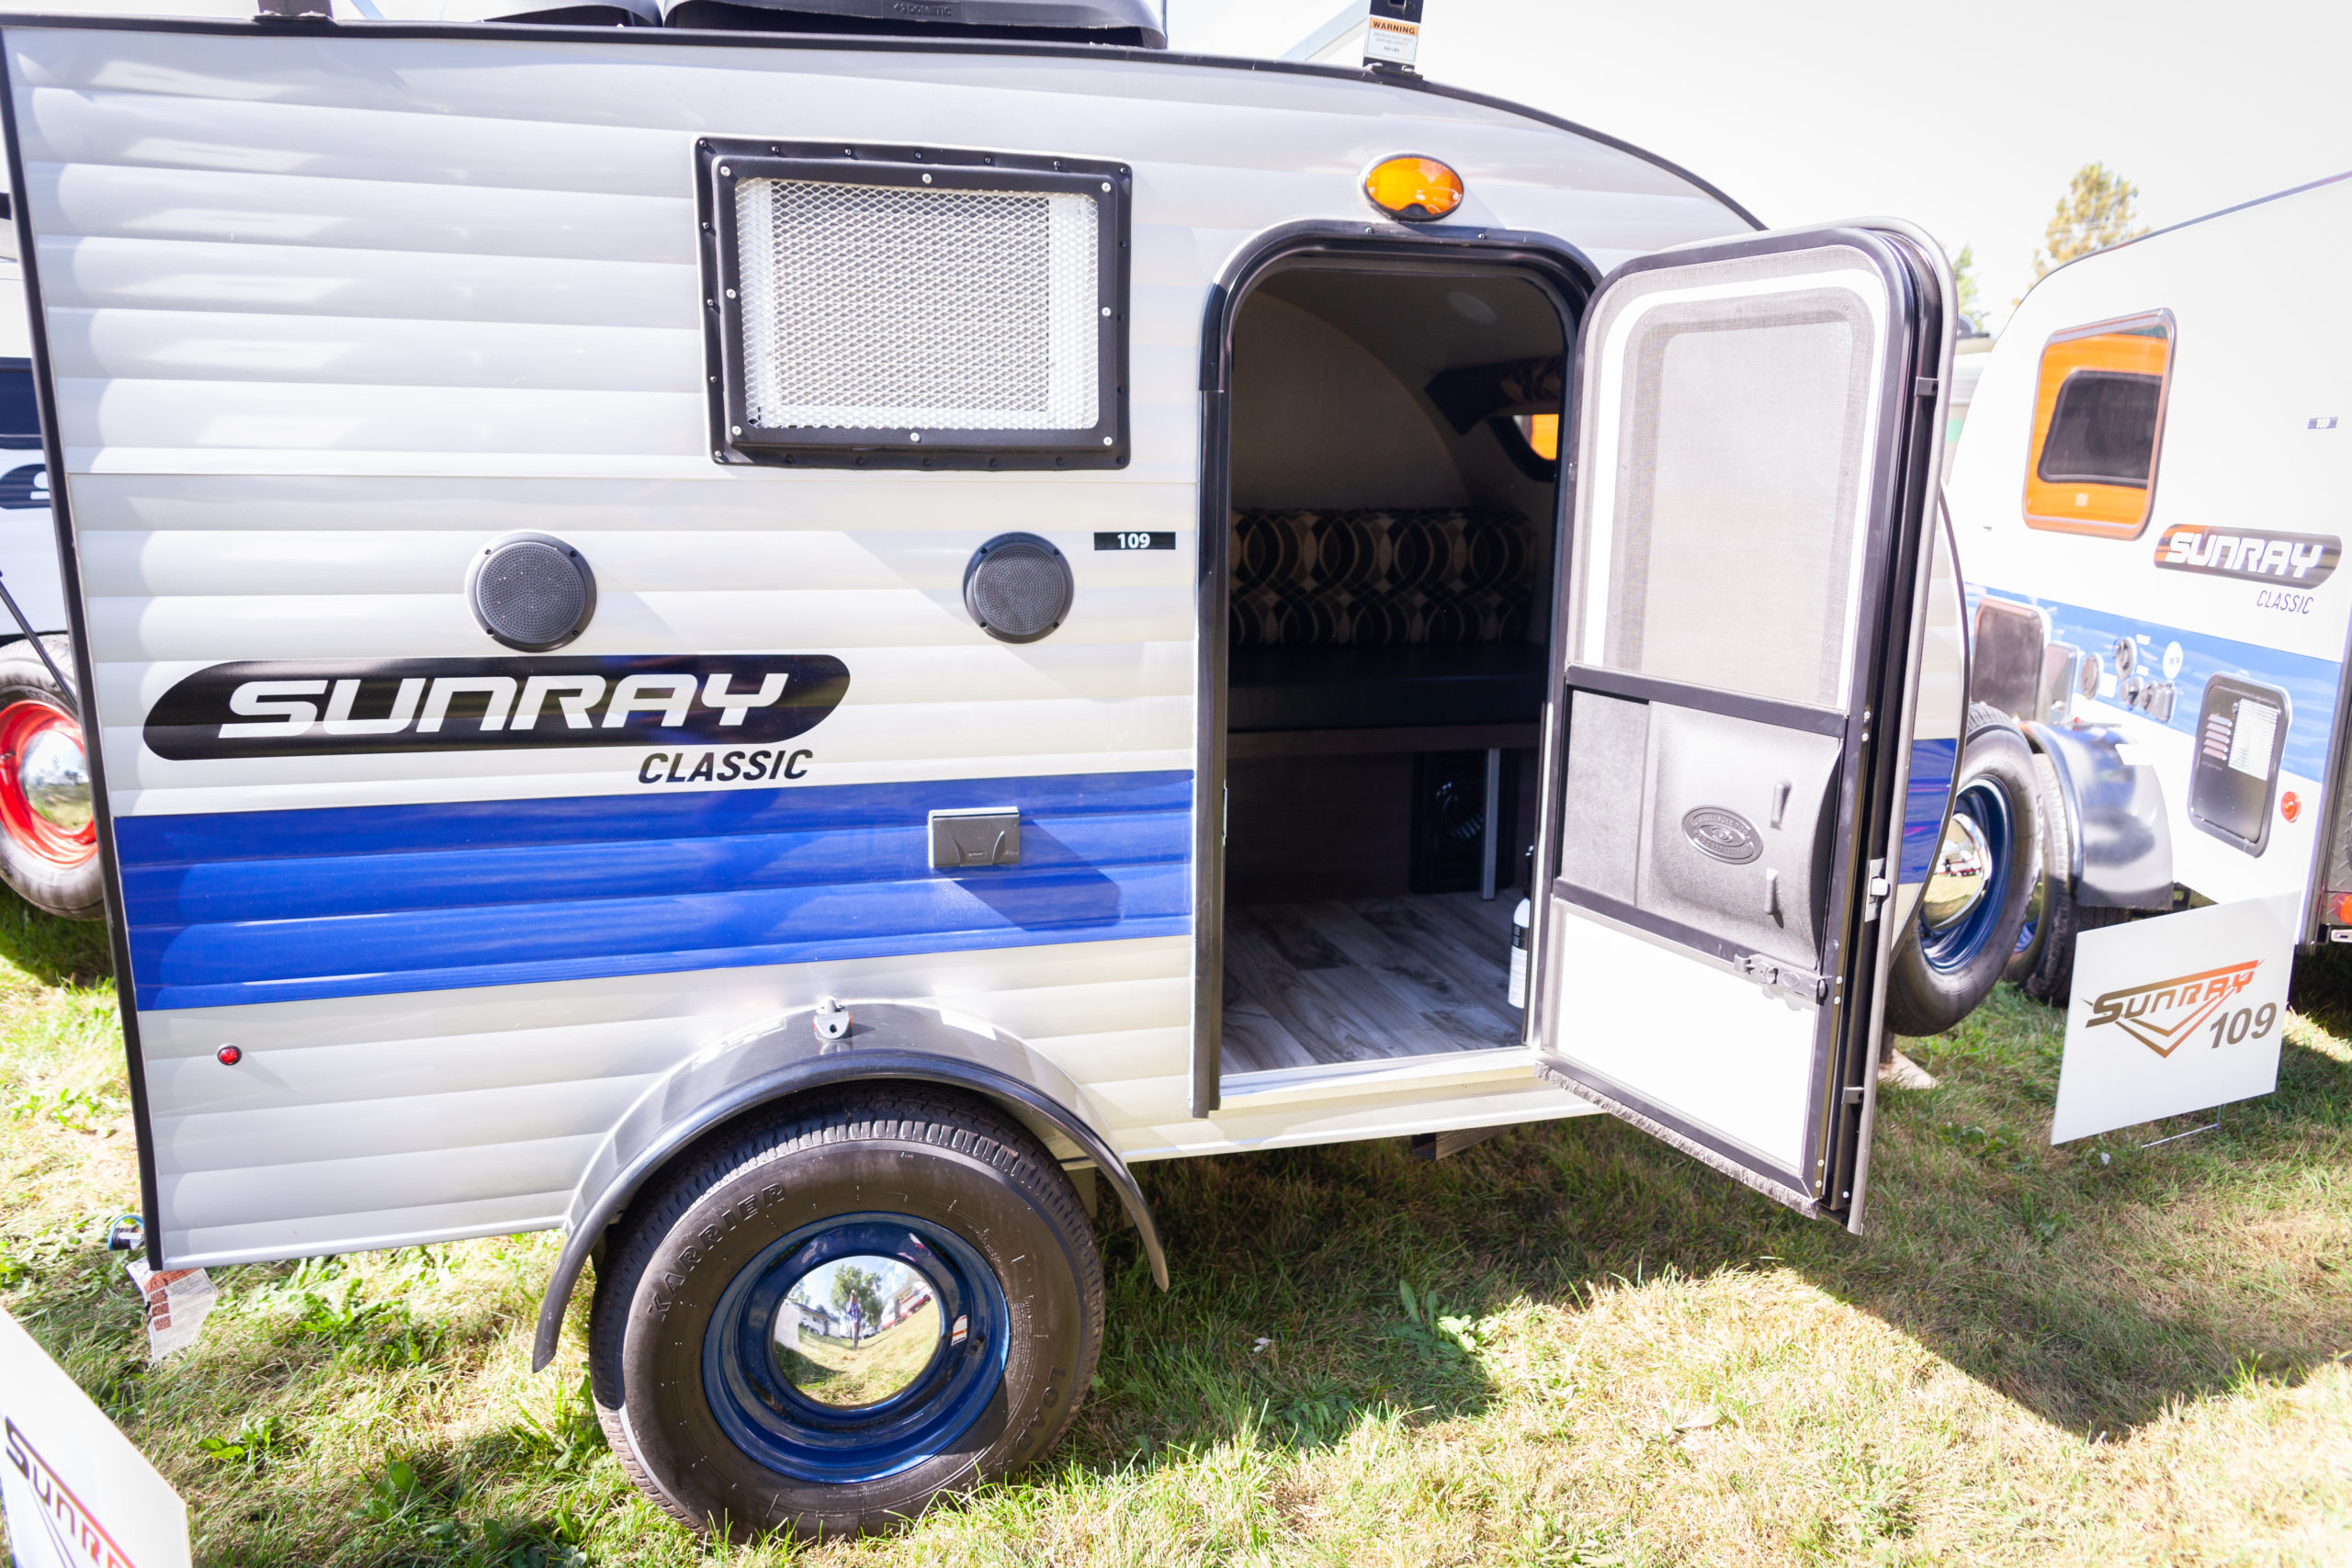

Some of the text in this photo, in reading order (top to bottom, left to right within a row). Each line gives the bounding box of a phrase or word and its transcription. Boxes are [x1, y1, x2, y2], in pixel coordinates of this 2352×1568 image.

[1374, 20, 1415, 35] WARNING
[1117, 533, 1150, 549] 109
[2165, 532, 2324, 578] SUNRAY
[2256, 590, 2314, 615] CLASSIC
[218, 672, 790, 739] SUNRAY
[639, 749, 814, 785] CLASSIC
[2085, 959, 2278, 1049] SUNRAY 109
[648, 1183, 786, 1322] KARRIER
[1015, 1365, 1067, 1451] LOAD
